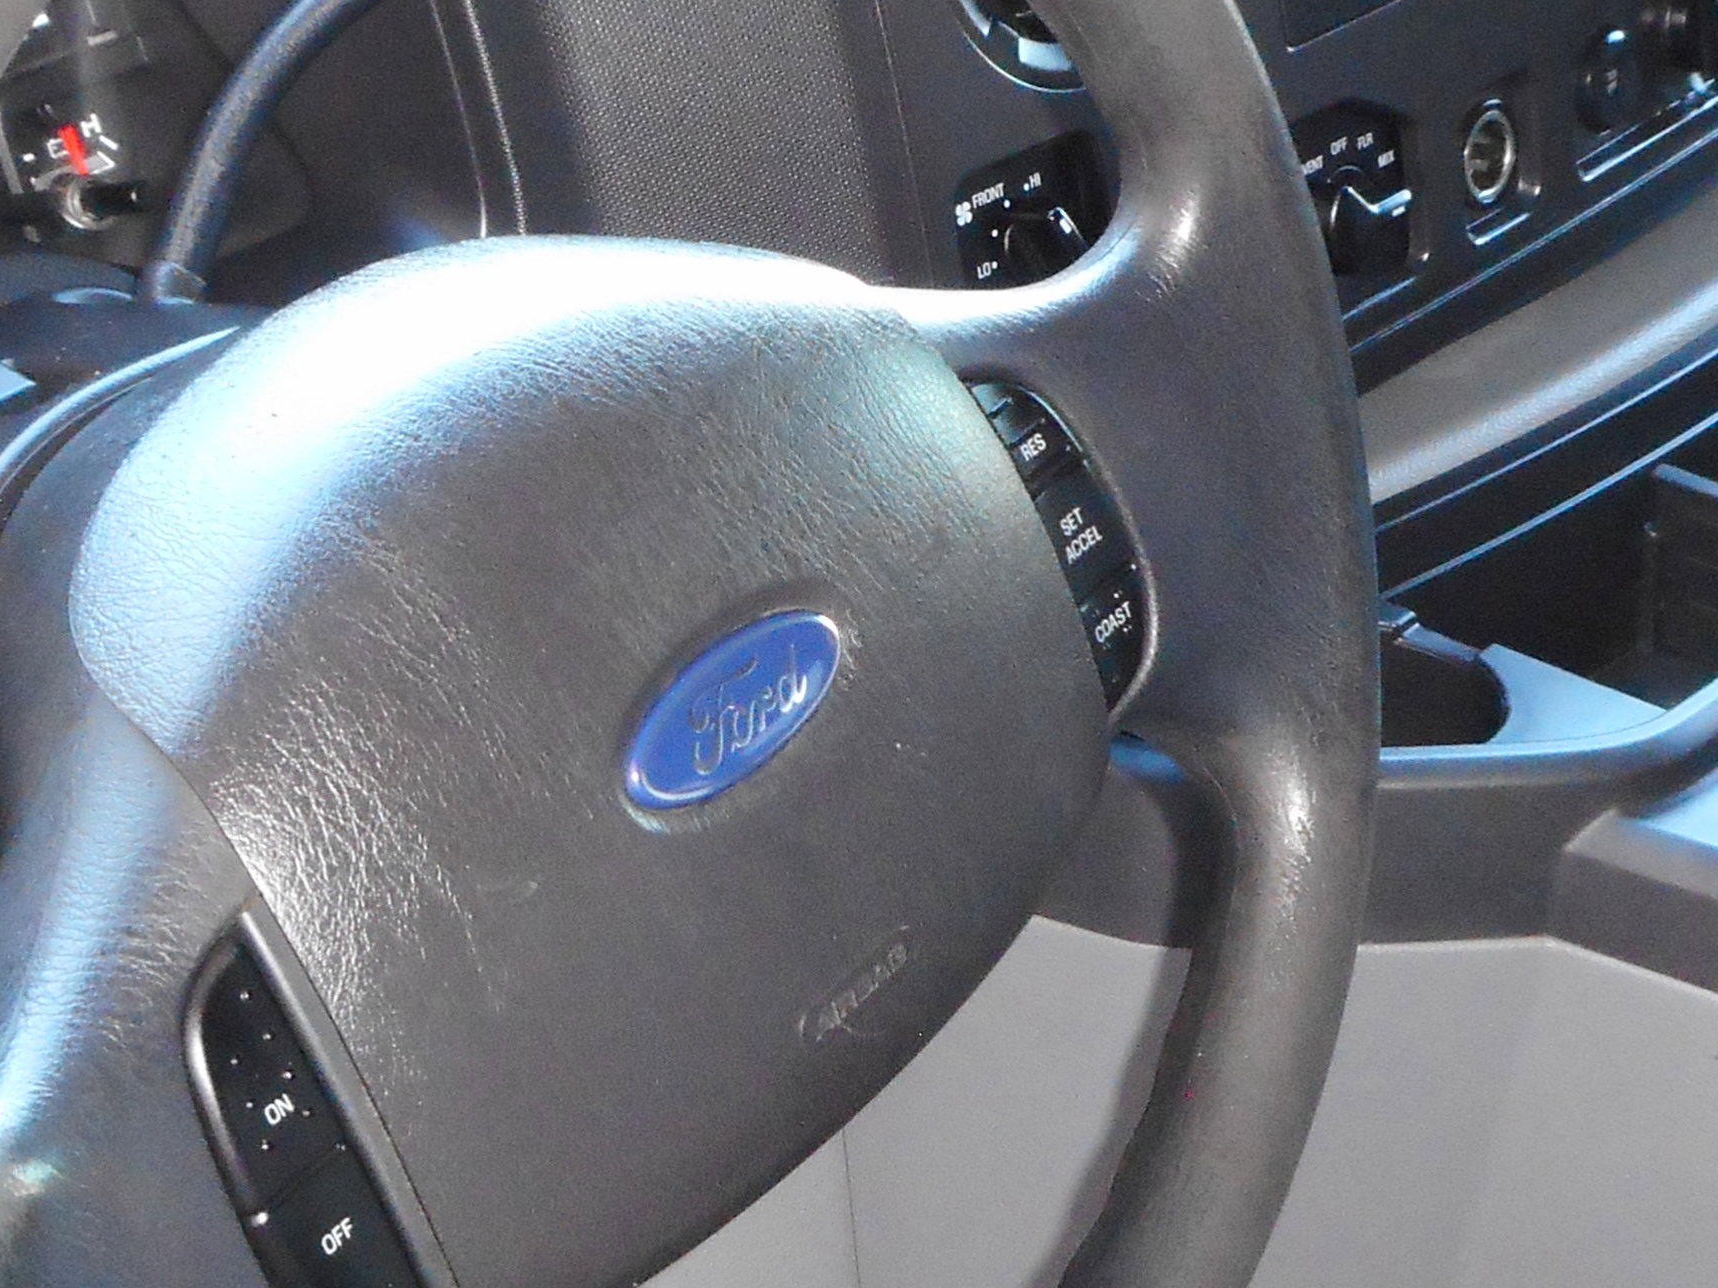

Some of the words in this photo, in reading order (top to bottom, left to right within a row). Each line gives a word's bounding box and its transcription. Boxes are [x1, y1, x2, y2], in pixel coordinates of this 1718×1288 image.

[1330, 136, 1347, 155] OFF
[1357, 132, 1374, 150] FLR
[1029, 172, 1042, 188] HI
[971, 182, 1004, 209] FRONT
[977, 262, 992, 279] LO
[1020, 433, 1047, 461] RES
[1060, 507, 1084, 537] SET
[1064, 525, 1103, 565] ACCEL
[1095, 601, 1133, 643] COAST
[690, 643, 808, 776] Ford
[264, 1093, 295, 1126] ON
[321, 1216, 354, 1256] OFF
